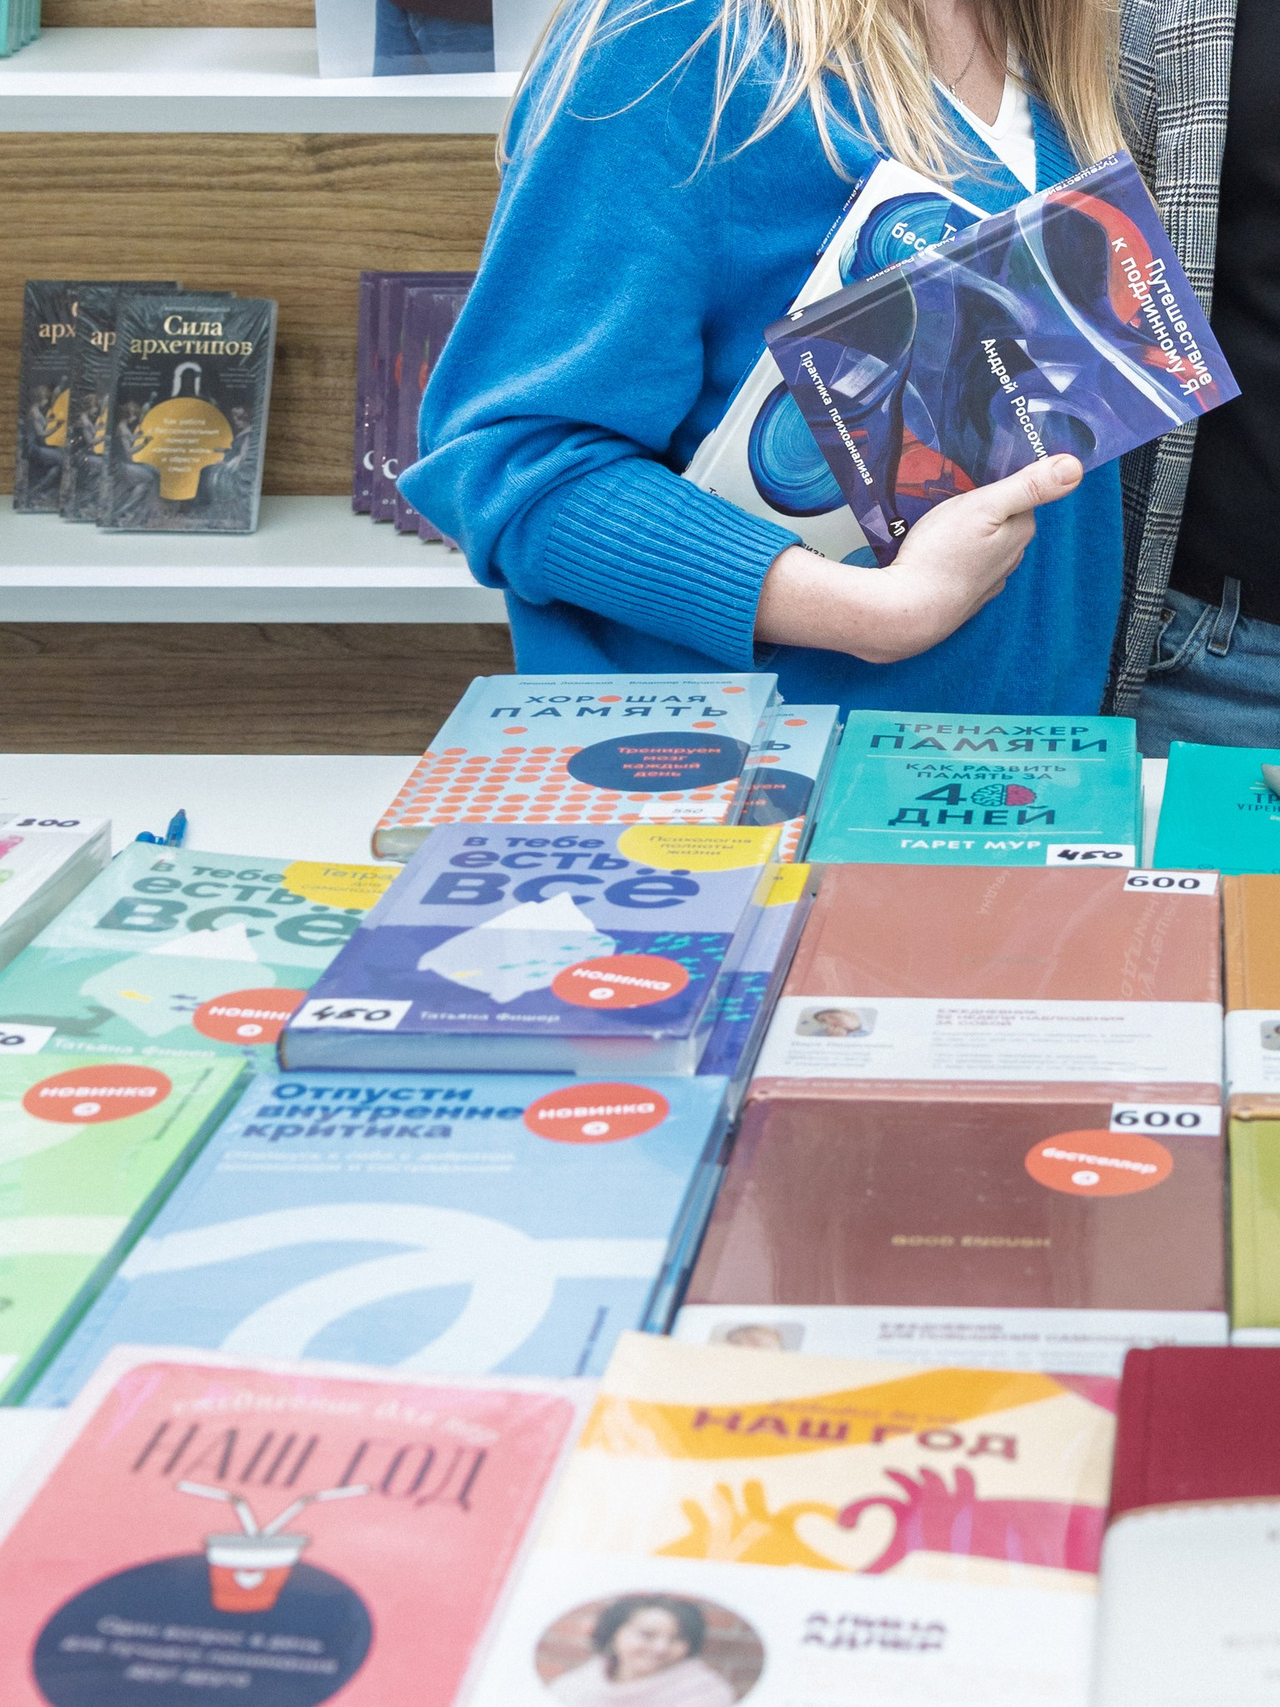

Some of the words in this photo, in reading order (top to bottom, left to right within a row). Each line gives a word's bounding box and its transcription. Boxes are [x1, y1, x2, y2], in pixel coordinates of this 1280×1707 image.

[163, 314, 223, 337] Сила
[1120, 256, 1186, 375] подлинному
[1178, 378, 1200, 397] Я
[1146, 259, 1212, 387] Путешествие
[130, 337, 254, 360] архетипов
[980, 337, 1016, 394] Андрей
[1010, 394, 1049, 461] Россохи
[799, 350, 832, 406] Практика
[828, 409, 875, 487] психоанализа
[489, 705, 729, 719] ПАМЯТЬ
[894, 722, 1090, 737] ТРЕНАЖЕР
[617, 747, 722, 755] Тренируем
[869, 734, 1108, 754] ПАМЯТИ
[622, 762, 702, 770] каждый
[906, 762, 954, 772] КАК
[962, 763, 1067, 773] РАЗВИТЬ
[916, 770, 1013, 781] ПАМЯТЬ
[1022, 771, 1054, 781] ЗА
[887, 804, 1058, 828] ДНЕЙ
[503, 835, 606, 849] тебе
[649, 835, 752, 844] Психология
[900, 838, 975, 850] ГАРЕТ
[983, 839, 1043, 851] МУР
[448, 850, 631, 873] есть
[1056, 848, 1124, 861] 450
[191, 865, 287, 882] тебе
[1126, 874, 1202, 890] 600
[132, 876, 307, 906] есть
[418, 867, 702, 910] всё
[311, 1005, 393, 1024] 450
[271, 1082, 474, 1105] Отпусти
[254, 1104, 524, 1123] внутренне
[1113, 1110, 1203, 1129] 600
[241, 1123, 453, 1143] критика
[691, 1406, 850, 1445] НАШ
[871, 1424, 1020, 1462] ГОД
